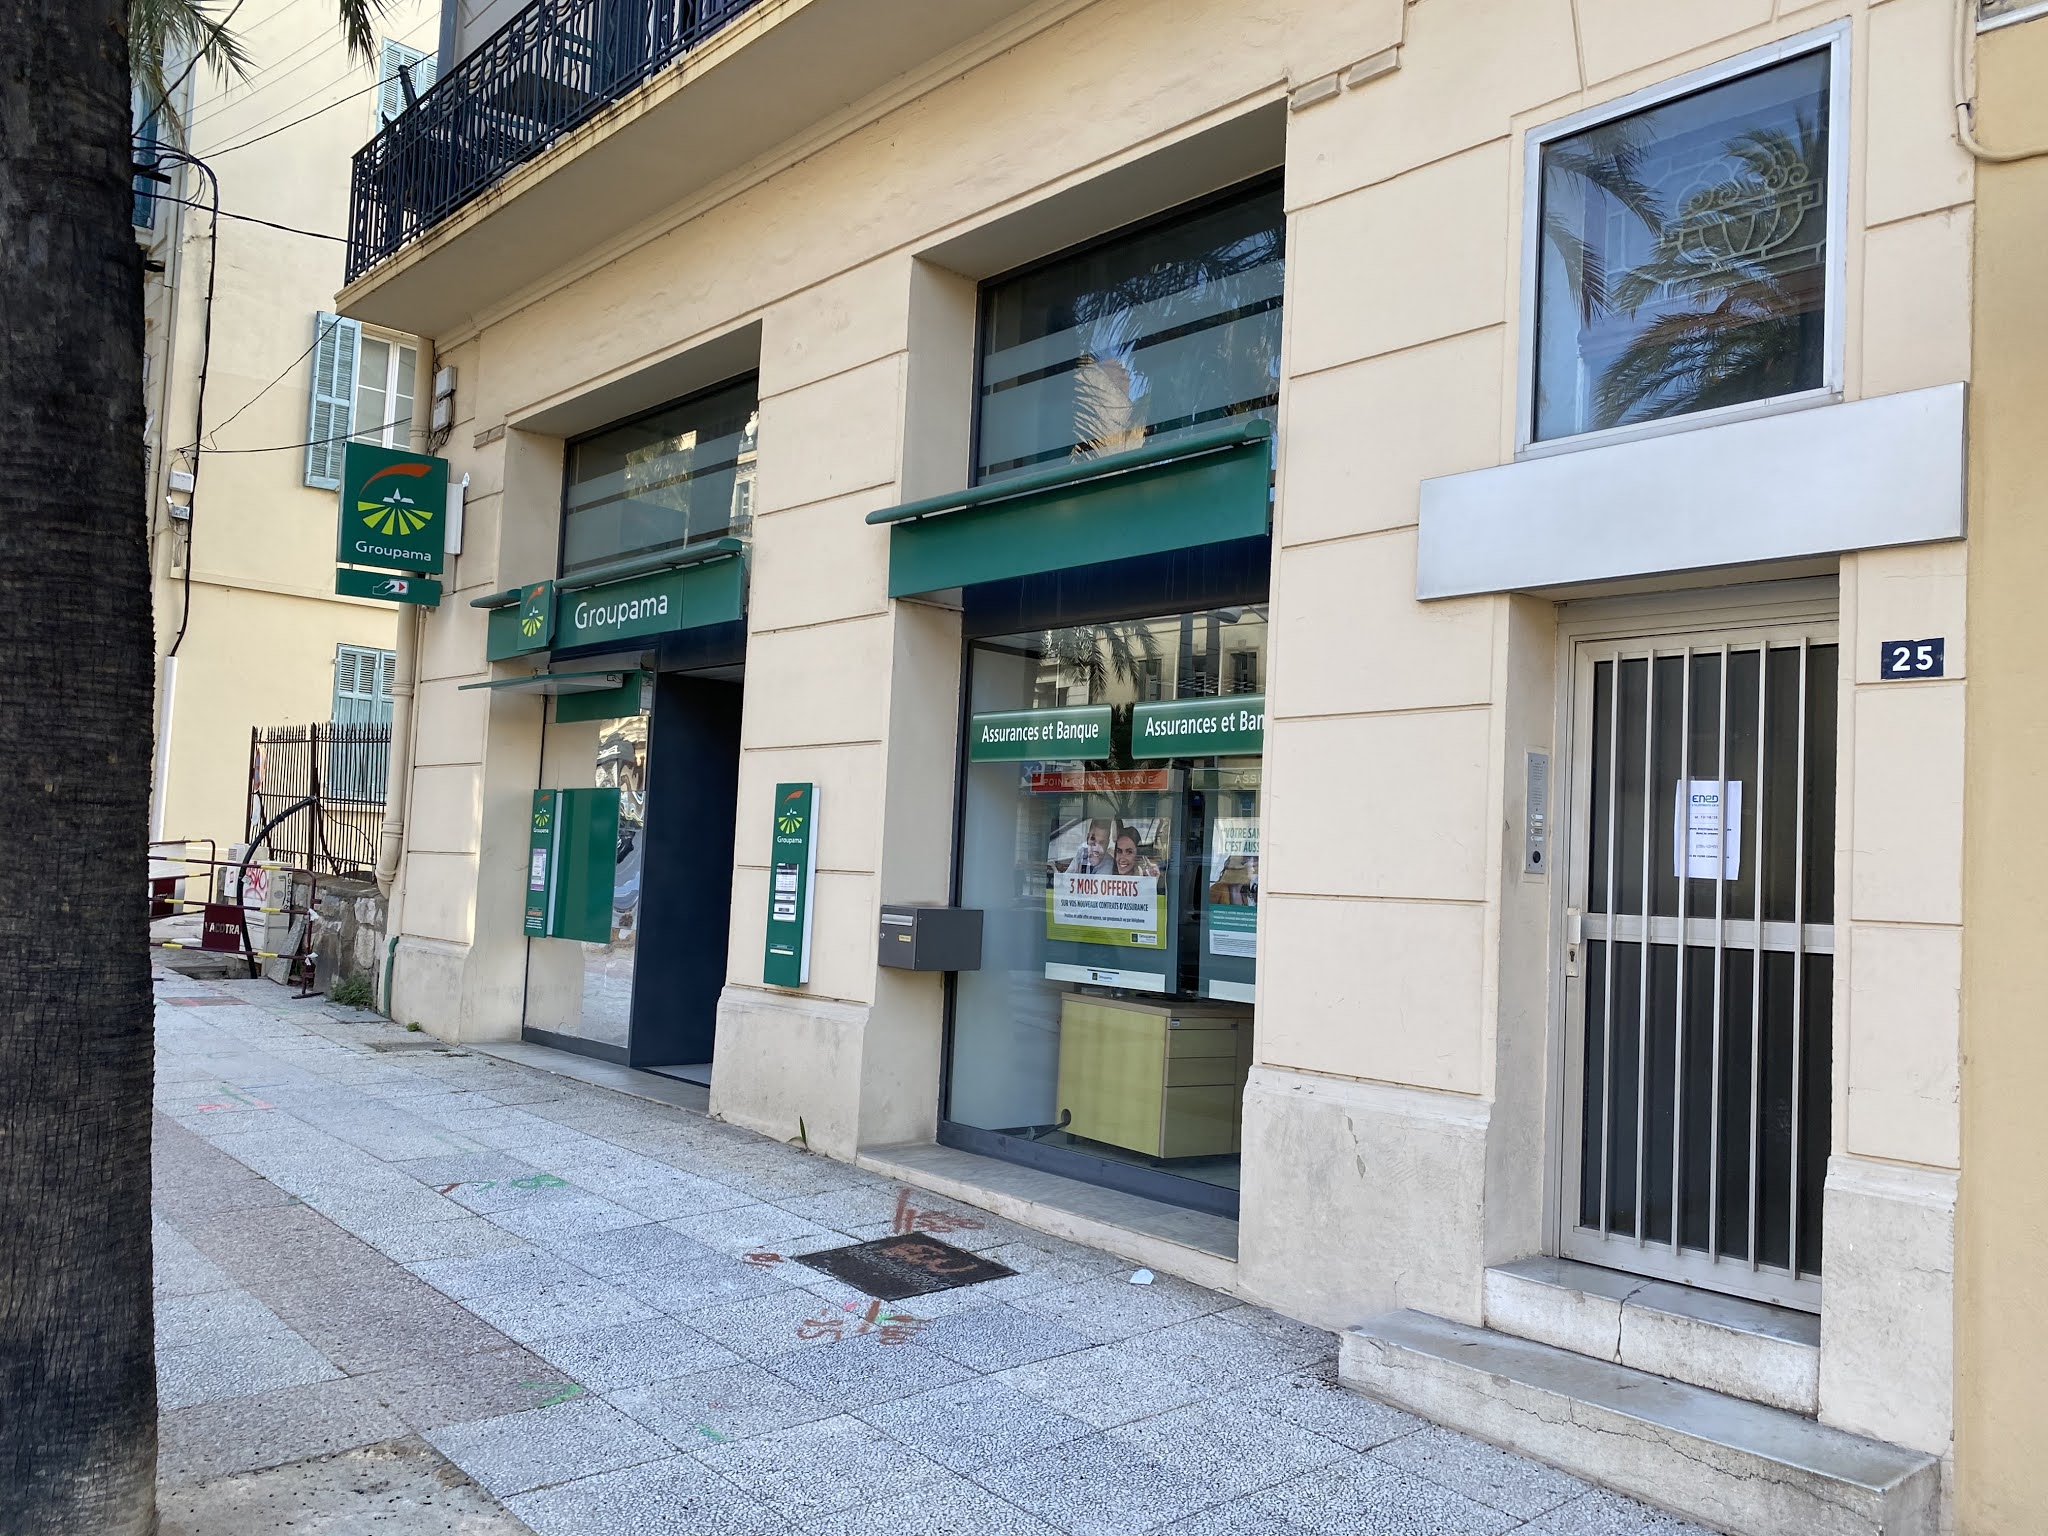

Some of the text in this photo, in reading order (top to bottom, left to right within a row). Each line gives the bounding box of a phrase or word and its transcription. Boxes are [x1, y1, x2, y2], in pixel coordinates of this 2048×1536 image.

[355, 540, 432, 562] Groupama
[574, 594, 668, 630] Groupama
[1892, 645, 1934, 672] 25
[981, 720, 1099, 744] Assurances et Banque
[1144, 716, 1217, 737] Assurances
[1221, 712, 1236, 732] et
[1072, 777, 1110, 786] CONSEIL
[1114, 775, 1155, 785] BANQUE
[776, 835, 802, 844] Groupama
[1069, 878, 1139, 897] 3 MOIS OFFERTS
[1069, 899, 1077, 907] VOS
[1077, 900, 1099, 909] NOUVEAUX
[1098, 901, 1119, 910] CONTRATS
[1119, 902, 1149, 912] D'ASSURANCE
